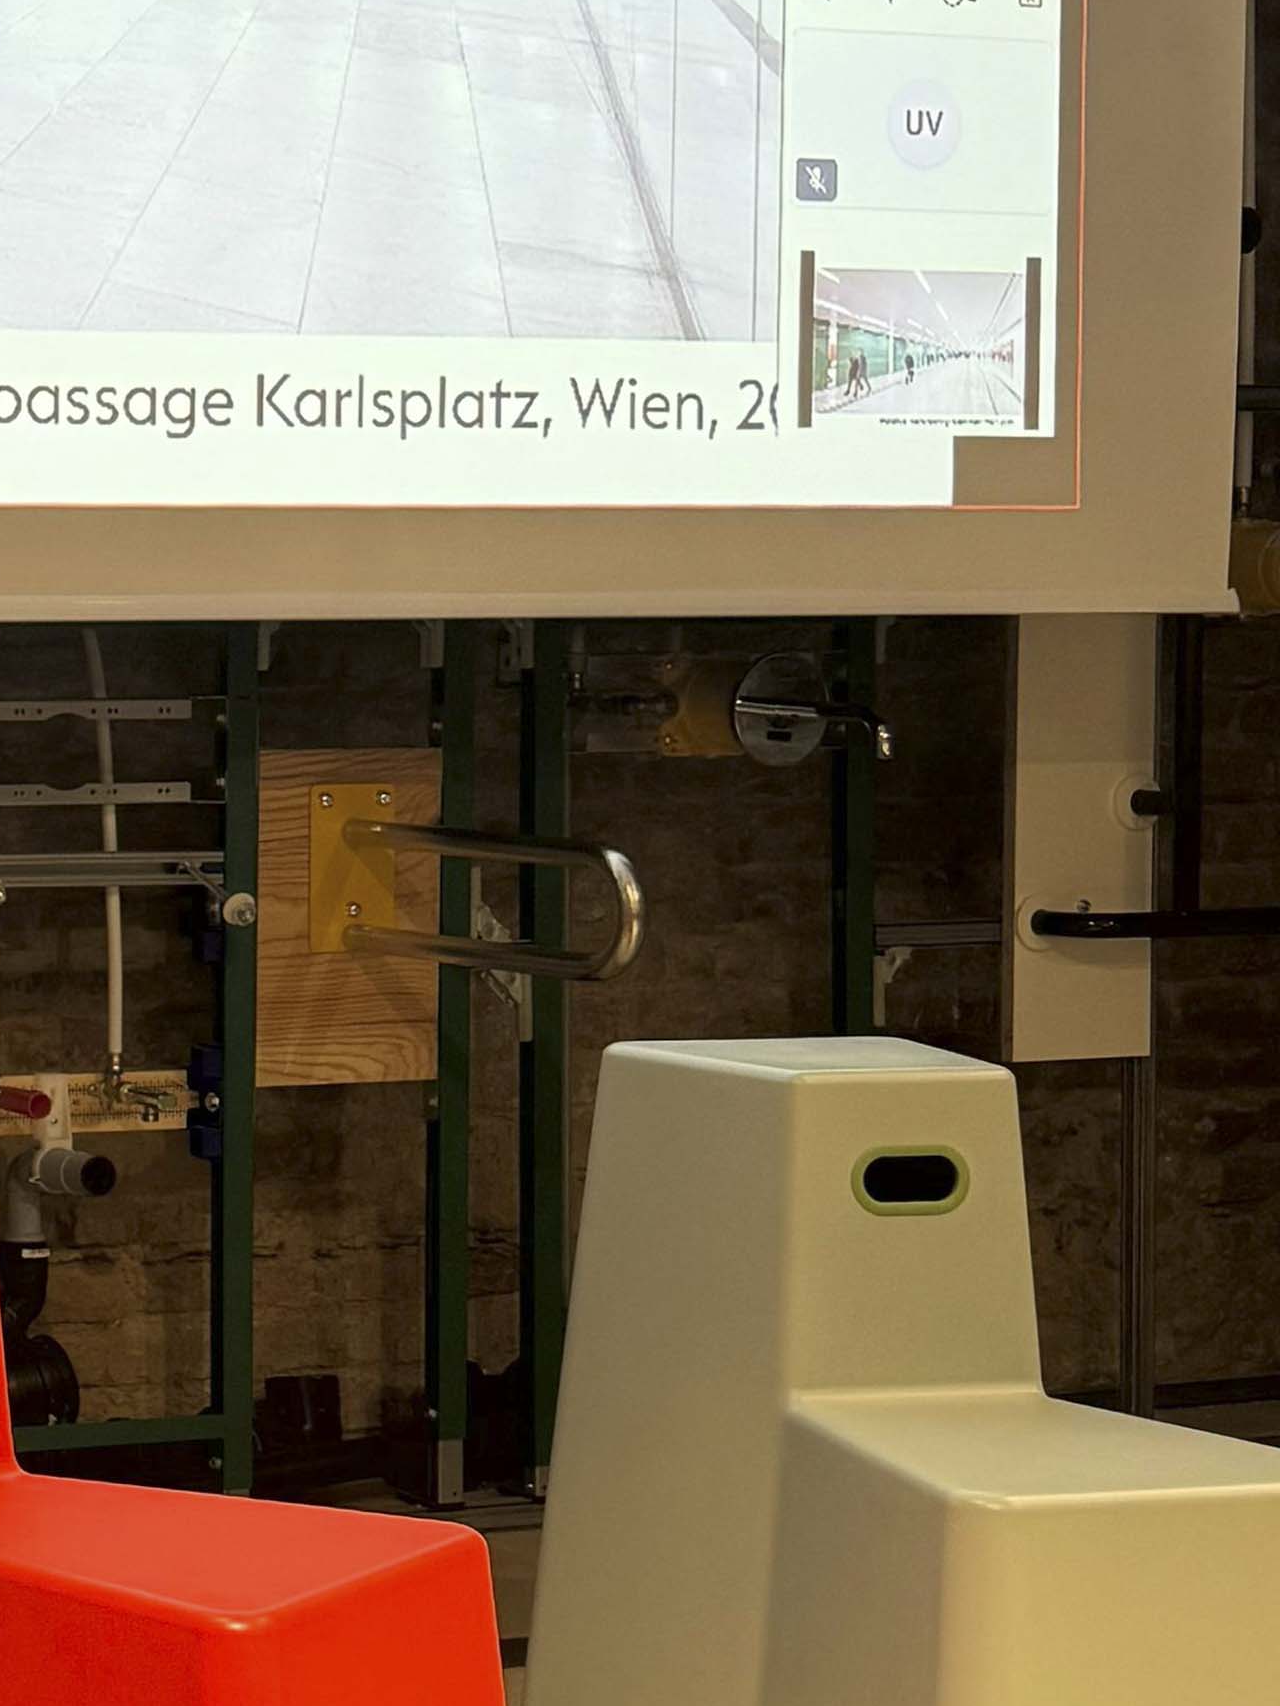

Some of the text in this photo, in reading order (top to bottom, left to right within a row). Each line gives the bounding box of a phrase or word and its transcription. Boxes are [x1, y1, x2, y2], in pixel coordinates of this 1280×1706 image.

[906, 109, 944, 137] UV
[256, 374, 553, 440] Karlsplatz,
[570, 377, 718, 440] Wien,
